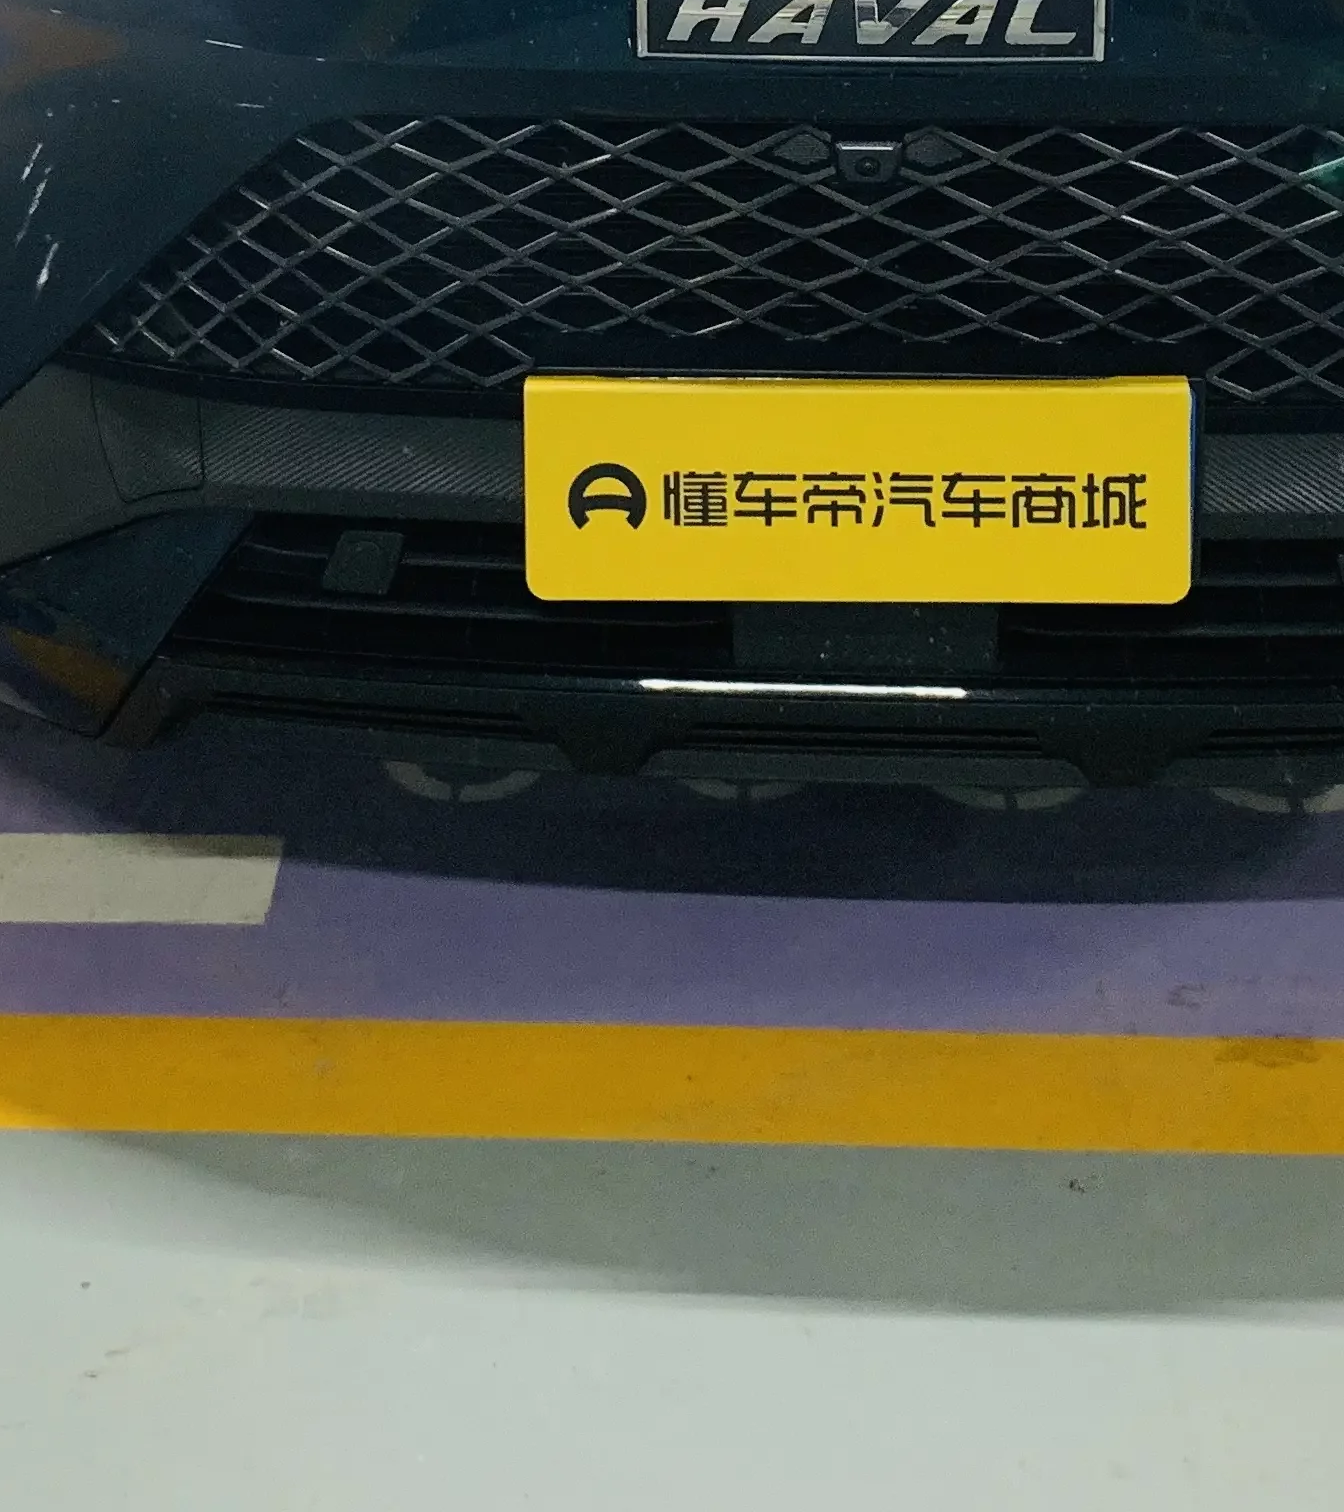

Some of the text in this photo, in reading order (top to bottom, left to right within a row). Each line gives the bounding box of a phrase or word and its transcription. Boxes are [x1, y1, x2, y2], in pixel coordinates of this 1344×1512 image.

[662, 470, 1148, 529] 懂车帝汽车商城
